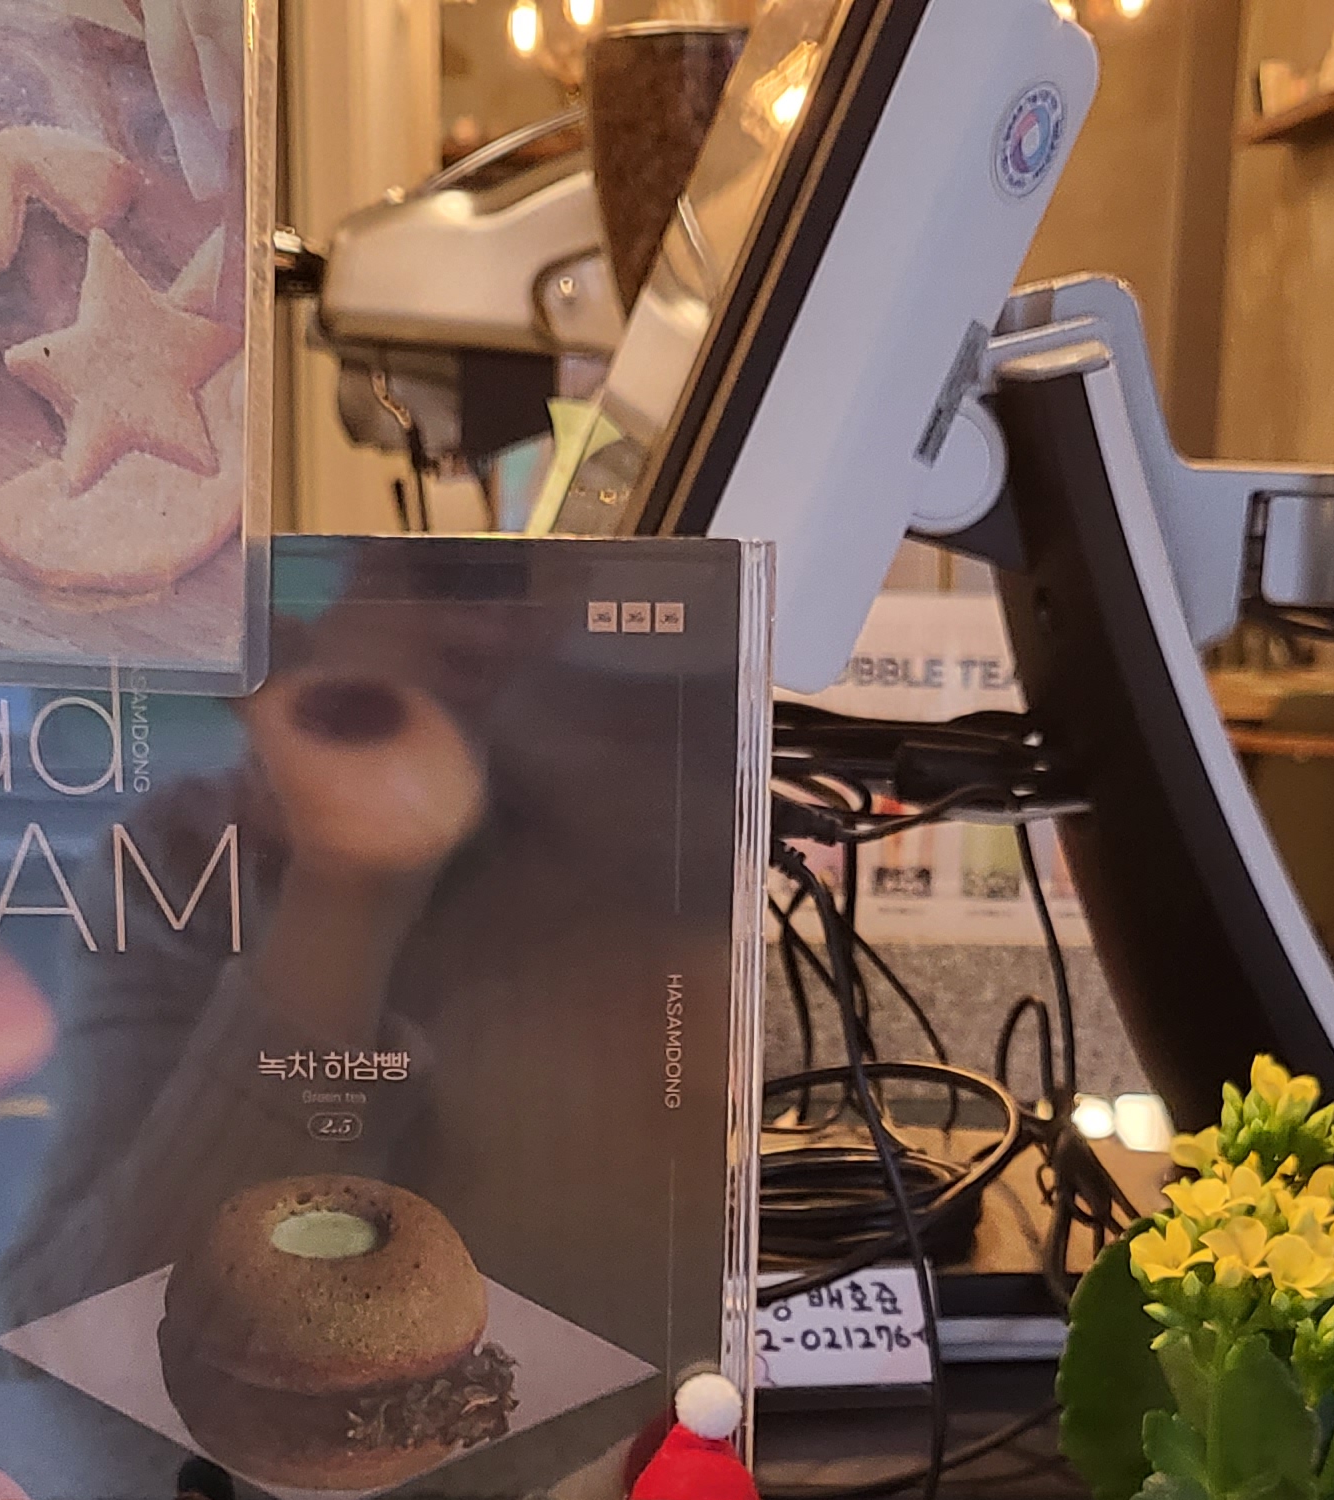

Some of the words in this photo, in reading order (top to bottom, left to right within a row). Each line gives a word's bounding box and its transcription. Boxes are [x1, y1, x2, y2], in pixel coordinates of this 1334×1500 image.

[664, 974, 683, 1109] HASAMDONG
[258, 1051, 317, 1081] 녹차
[322, 1051, 412, 1081] 하삼빵
[320, 1119, 353, 1134] 2.5
